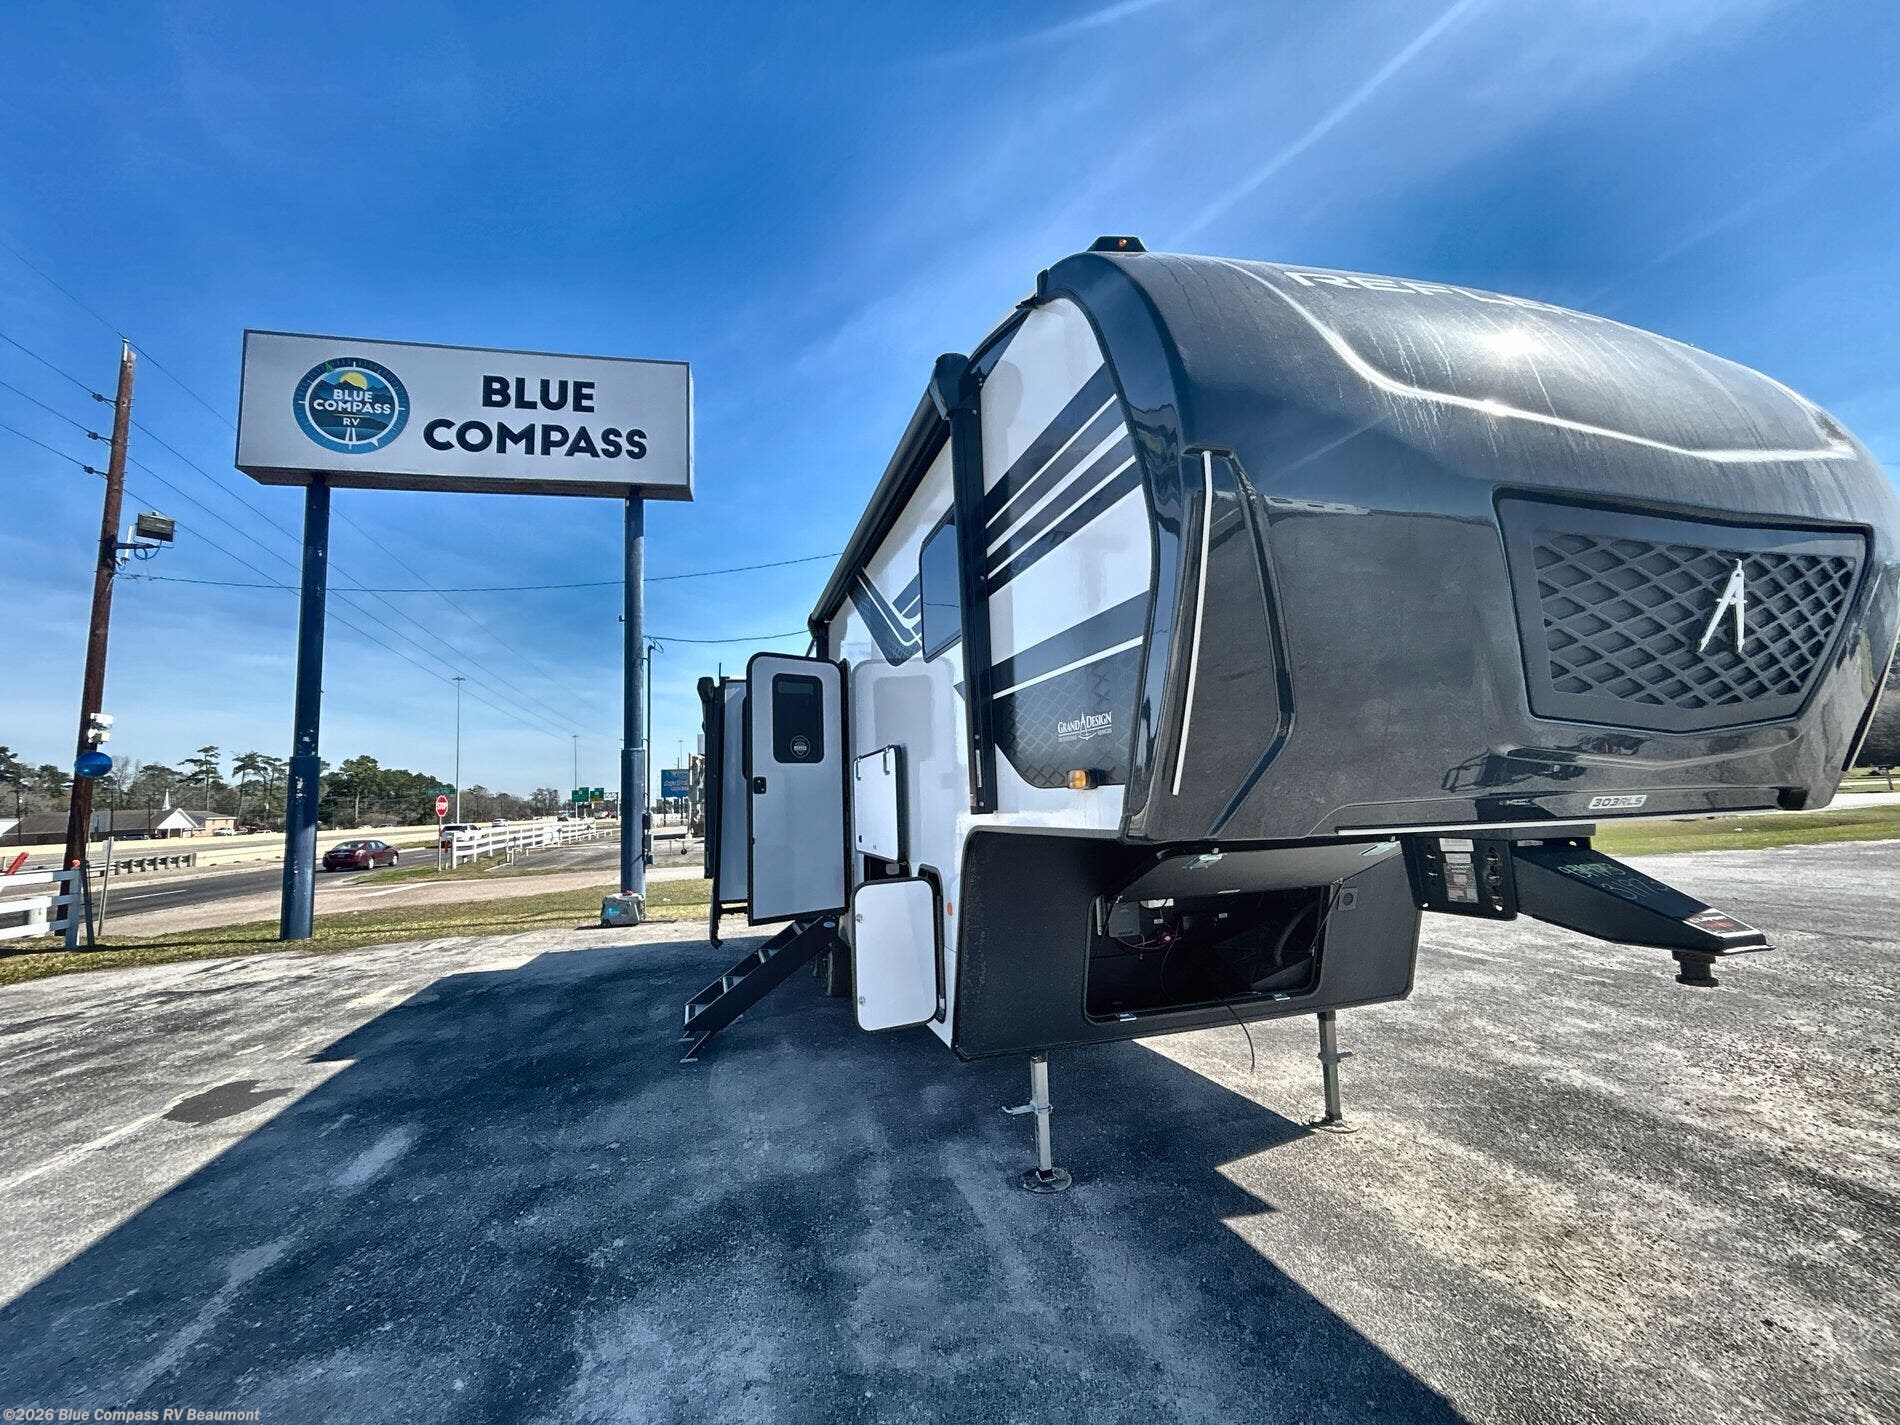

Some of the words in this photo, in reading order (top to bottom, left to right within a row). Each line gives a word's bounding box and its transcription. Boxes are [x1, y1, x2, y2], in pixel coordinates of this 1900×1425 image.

[333, 389, 373, 402] BLUE
[482, 375, 595, 412] BLUE
[313, 400, 391, 414] COMPASS
[343, 418, 360, 426] RV
[423, 418, 647, 460] COMPASS
[1057, 719, 1080, 734] GRAND
[1086, 711, 1112, 729] DESIGN
[1592, 796, 1644, 807] 303RLS
